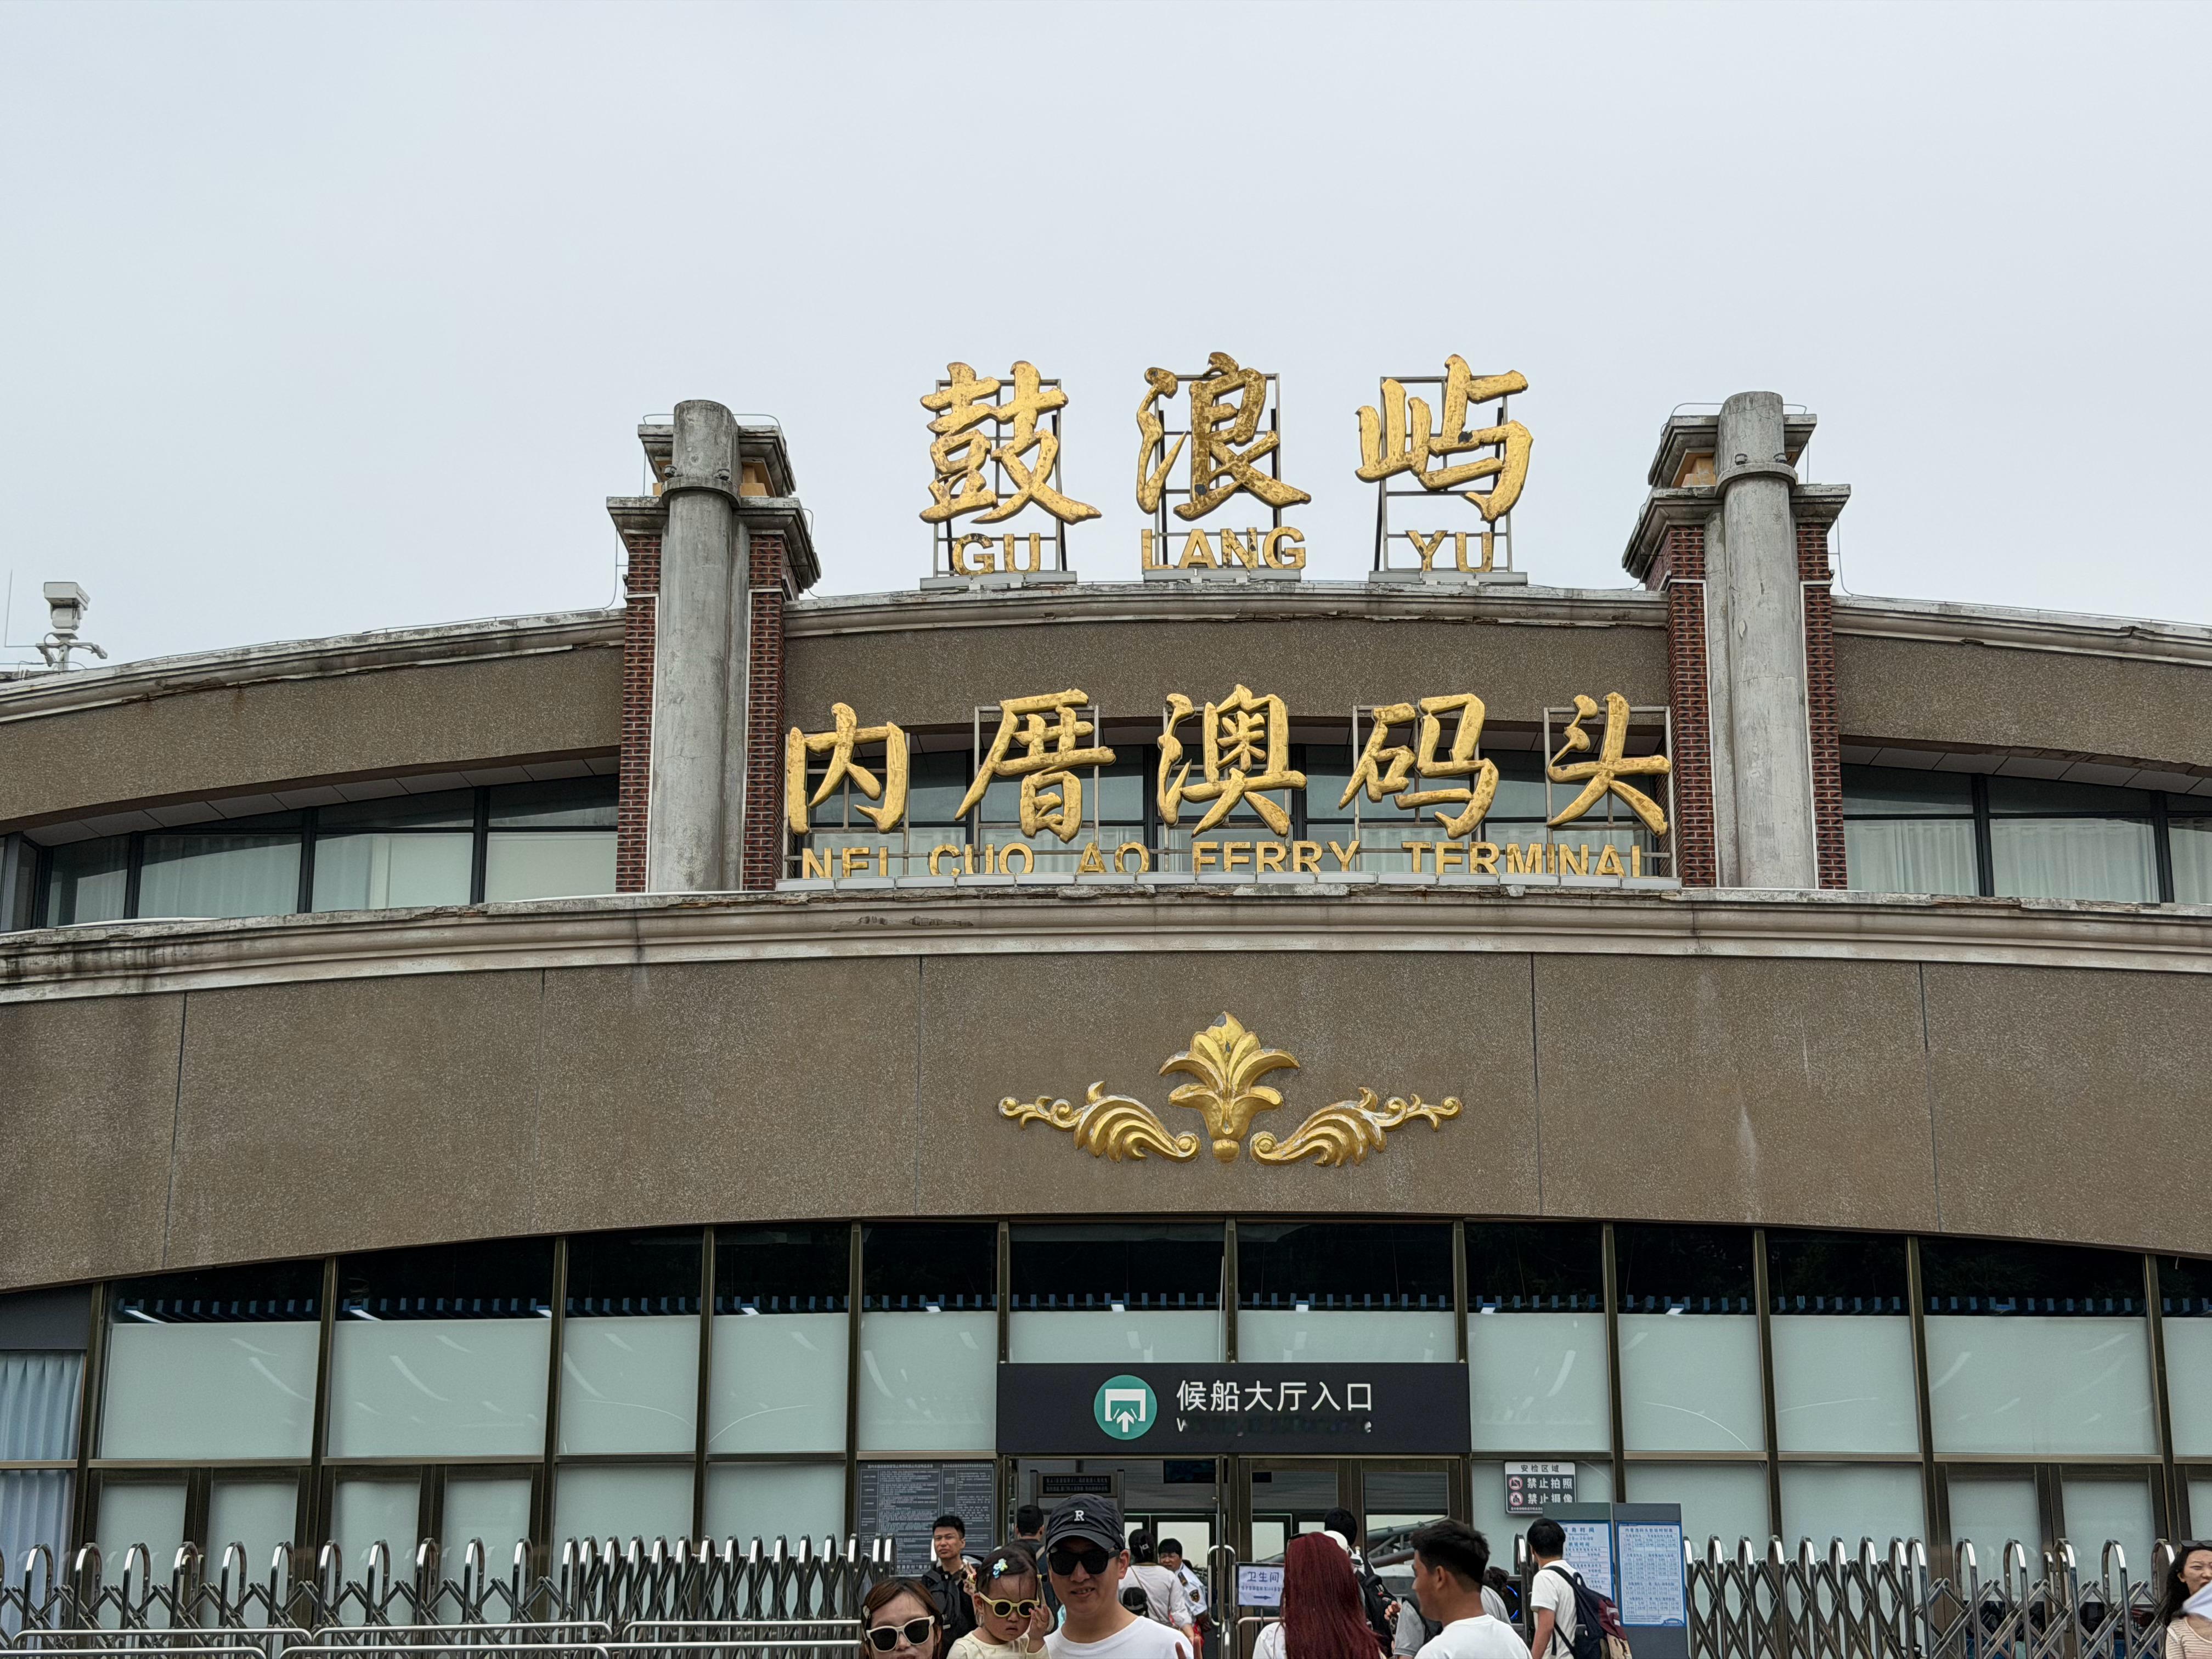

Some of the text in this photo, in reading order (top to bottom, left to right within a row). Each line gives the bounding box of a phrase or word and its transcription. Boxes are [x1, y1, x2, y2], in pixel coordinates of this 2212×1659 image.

[920, 352, 1533, 524] 鼓浪屿
[952, 527, 1493, 575] GU LANG YU
[928, 842, 1035, 876] CUO
[1077, 842, 1150, 873] AO
[1192, 840, 1361, 873] FERRY
[1176, 1380, 1372, 1412] 候船大厅入口
[1520, 1464, 1559, 1472] 安检区域
[1527, 1477, 1573, 1489] 禁止拍照
[1074, 1510, 1085, 1522] R
[1247, 1571, 1279, 1583] 卫生间
